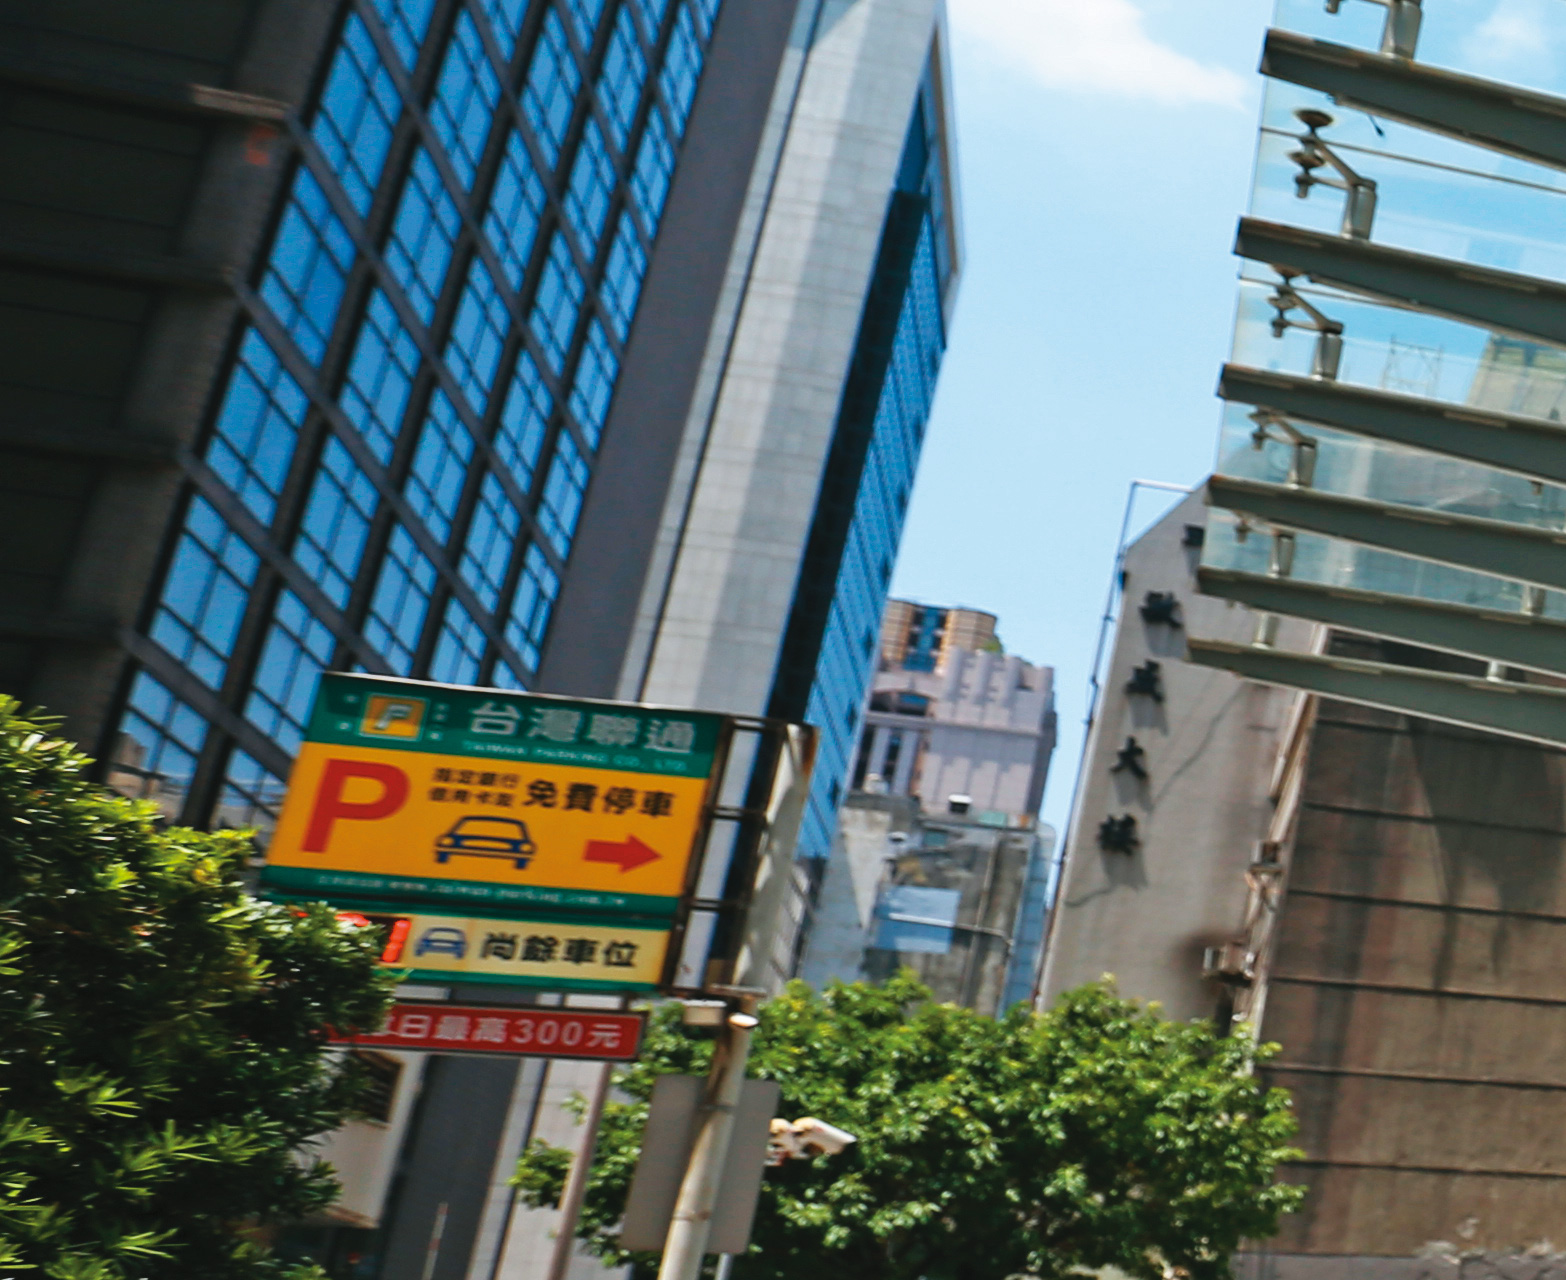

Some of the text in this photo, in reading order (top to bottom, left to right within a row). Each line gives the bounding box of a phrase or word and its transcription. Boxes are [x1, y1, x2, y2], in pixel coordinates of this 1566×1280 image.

[470, 701, 696, 755] 台灣聯通
[301, 759, 411, 854] P
[523, 779, 675, 818] 免費停車
[480, 931, 640, 968] 尚餘車位
